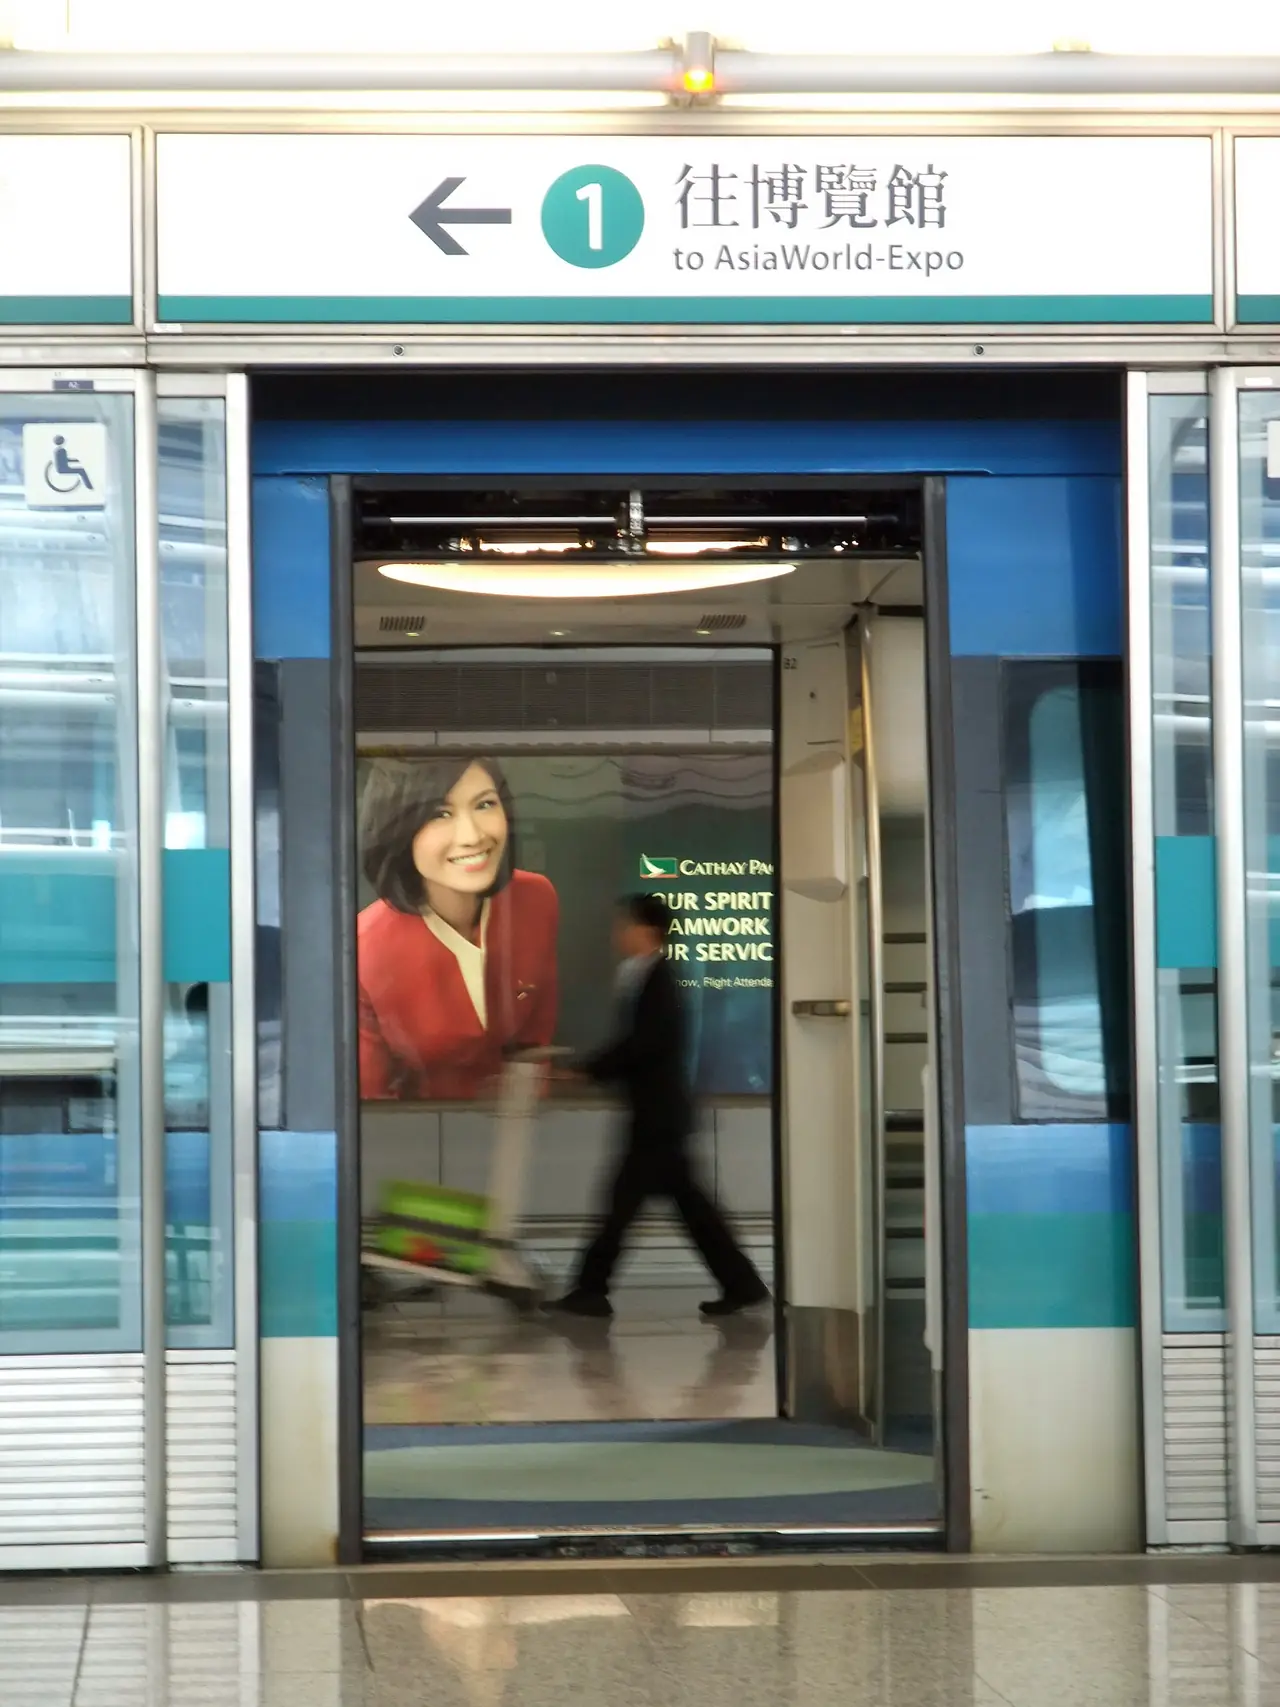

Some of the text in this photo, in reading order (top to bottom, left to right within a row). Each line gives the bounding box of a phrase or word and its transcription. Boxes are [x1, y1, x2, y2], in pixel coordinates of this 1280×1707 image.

[673, 163, 949, 230] 往博覽館
[575, 182, 604, 250] 1
[673, 244, 965, 277] to AsiaWorld-Expo
[679, 859, 747, 876] CATHAY
[704, 892, 774, 911] SPIRIT
[667, 917, 771, 936] AMWORK
